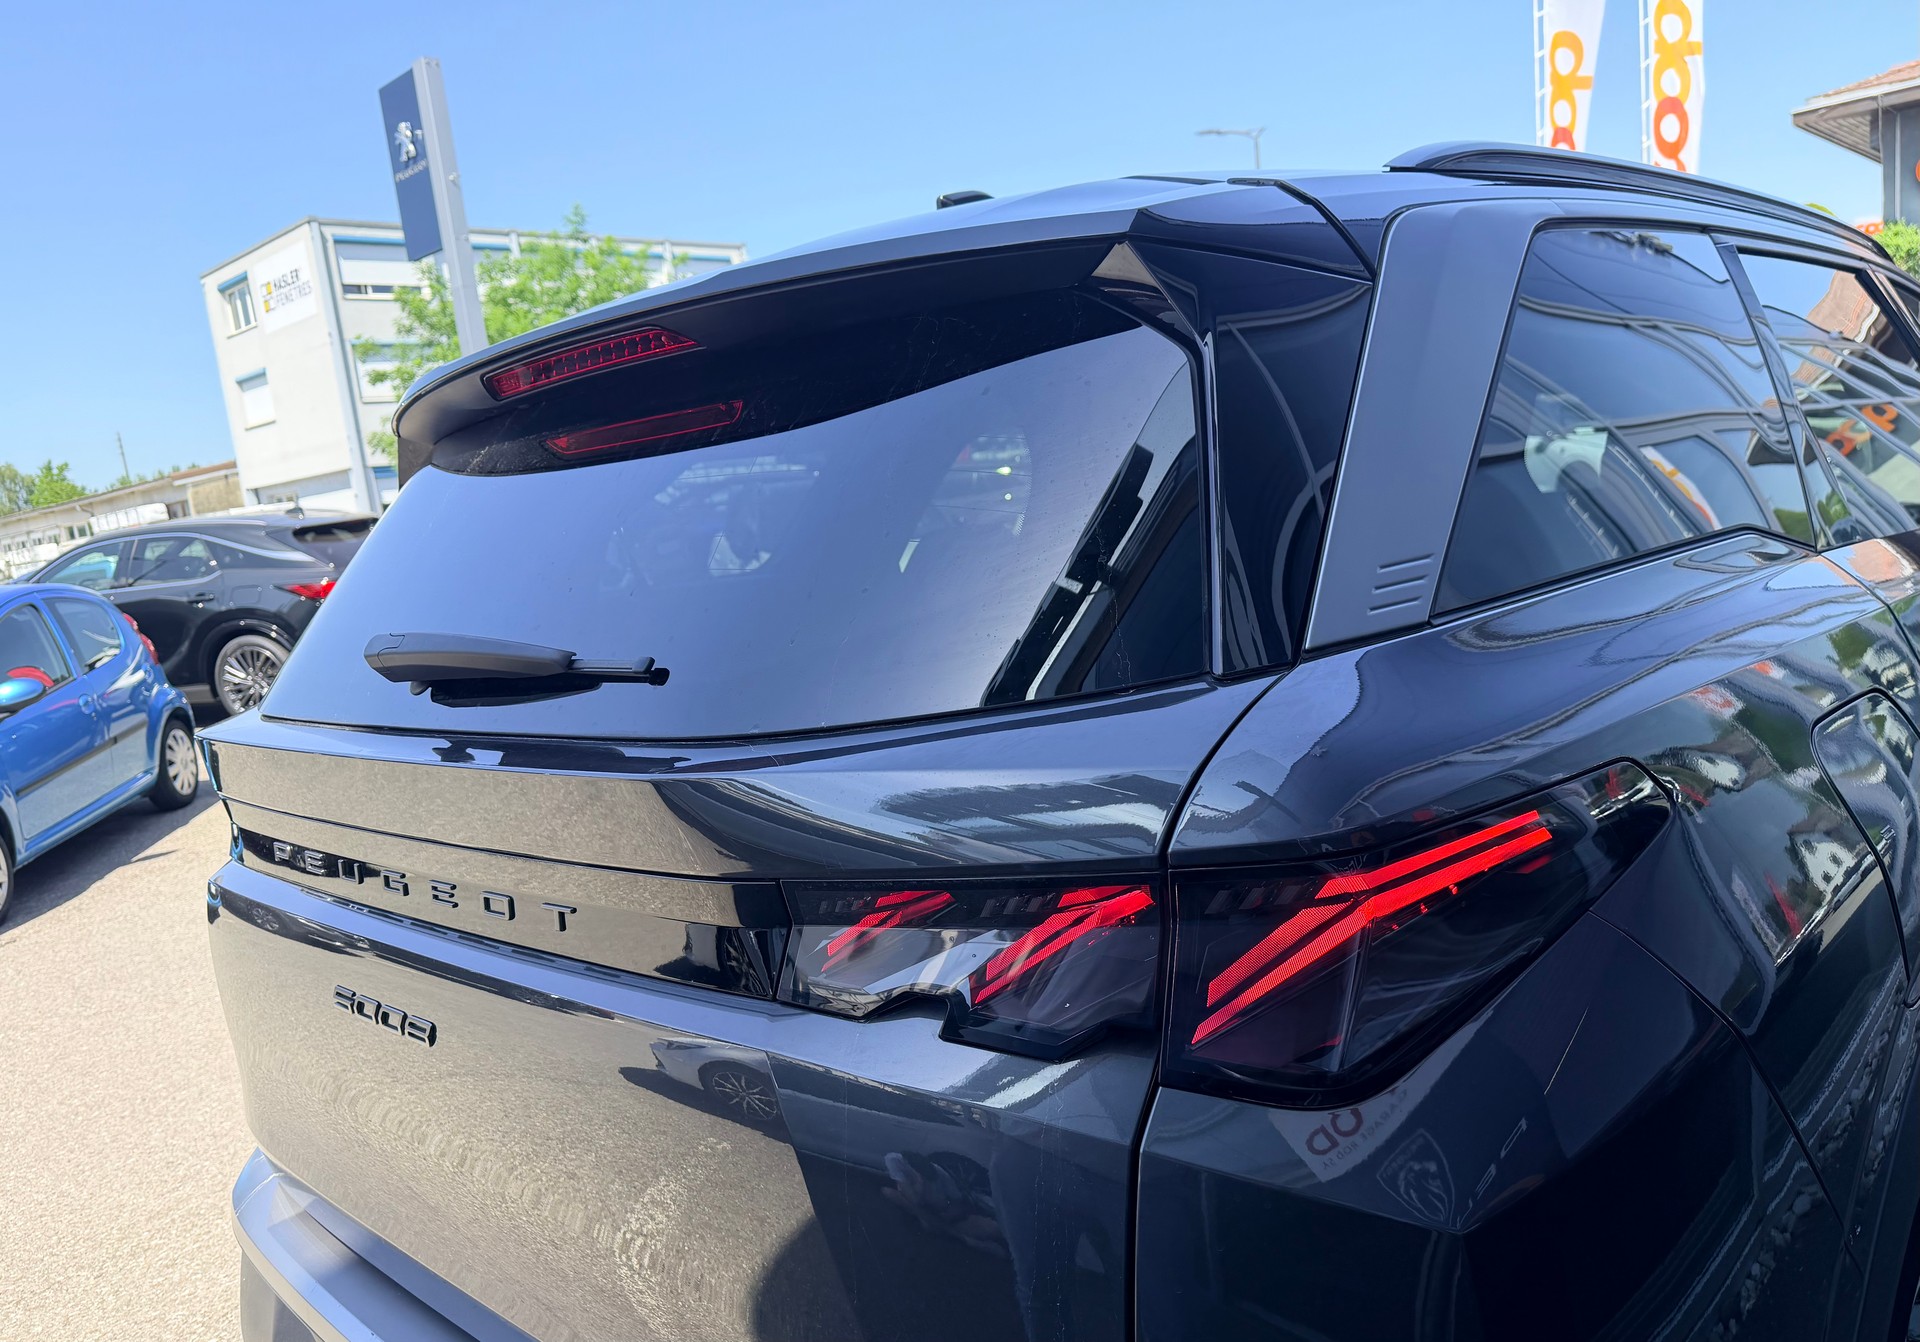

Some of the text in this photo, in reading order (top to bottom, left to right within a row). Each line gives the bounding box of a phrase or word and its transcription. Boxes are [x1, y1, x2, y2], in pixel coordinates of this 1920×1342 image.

[1653, 0, 1702, 172] oop
[273, 841, 577, 932] PEUGEOT
[333, 984, 438, 1048] 5008
